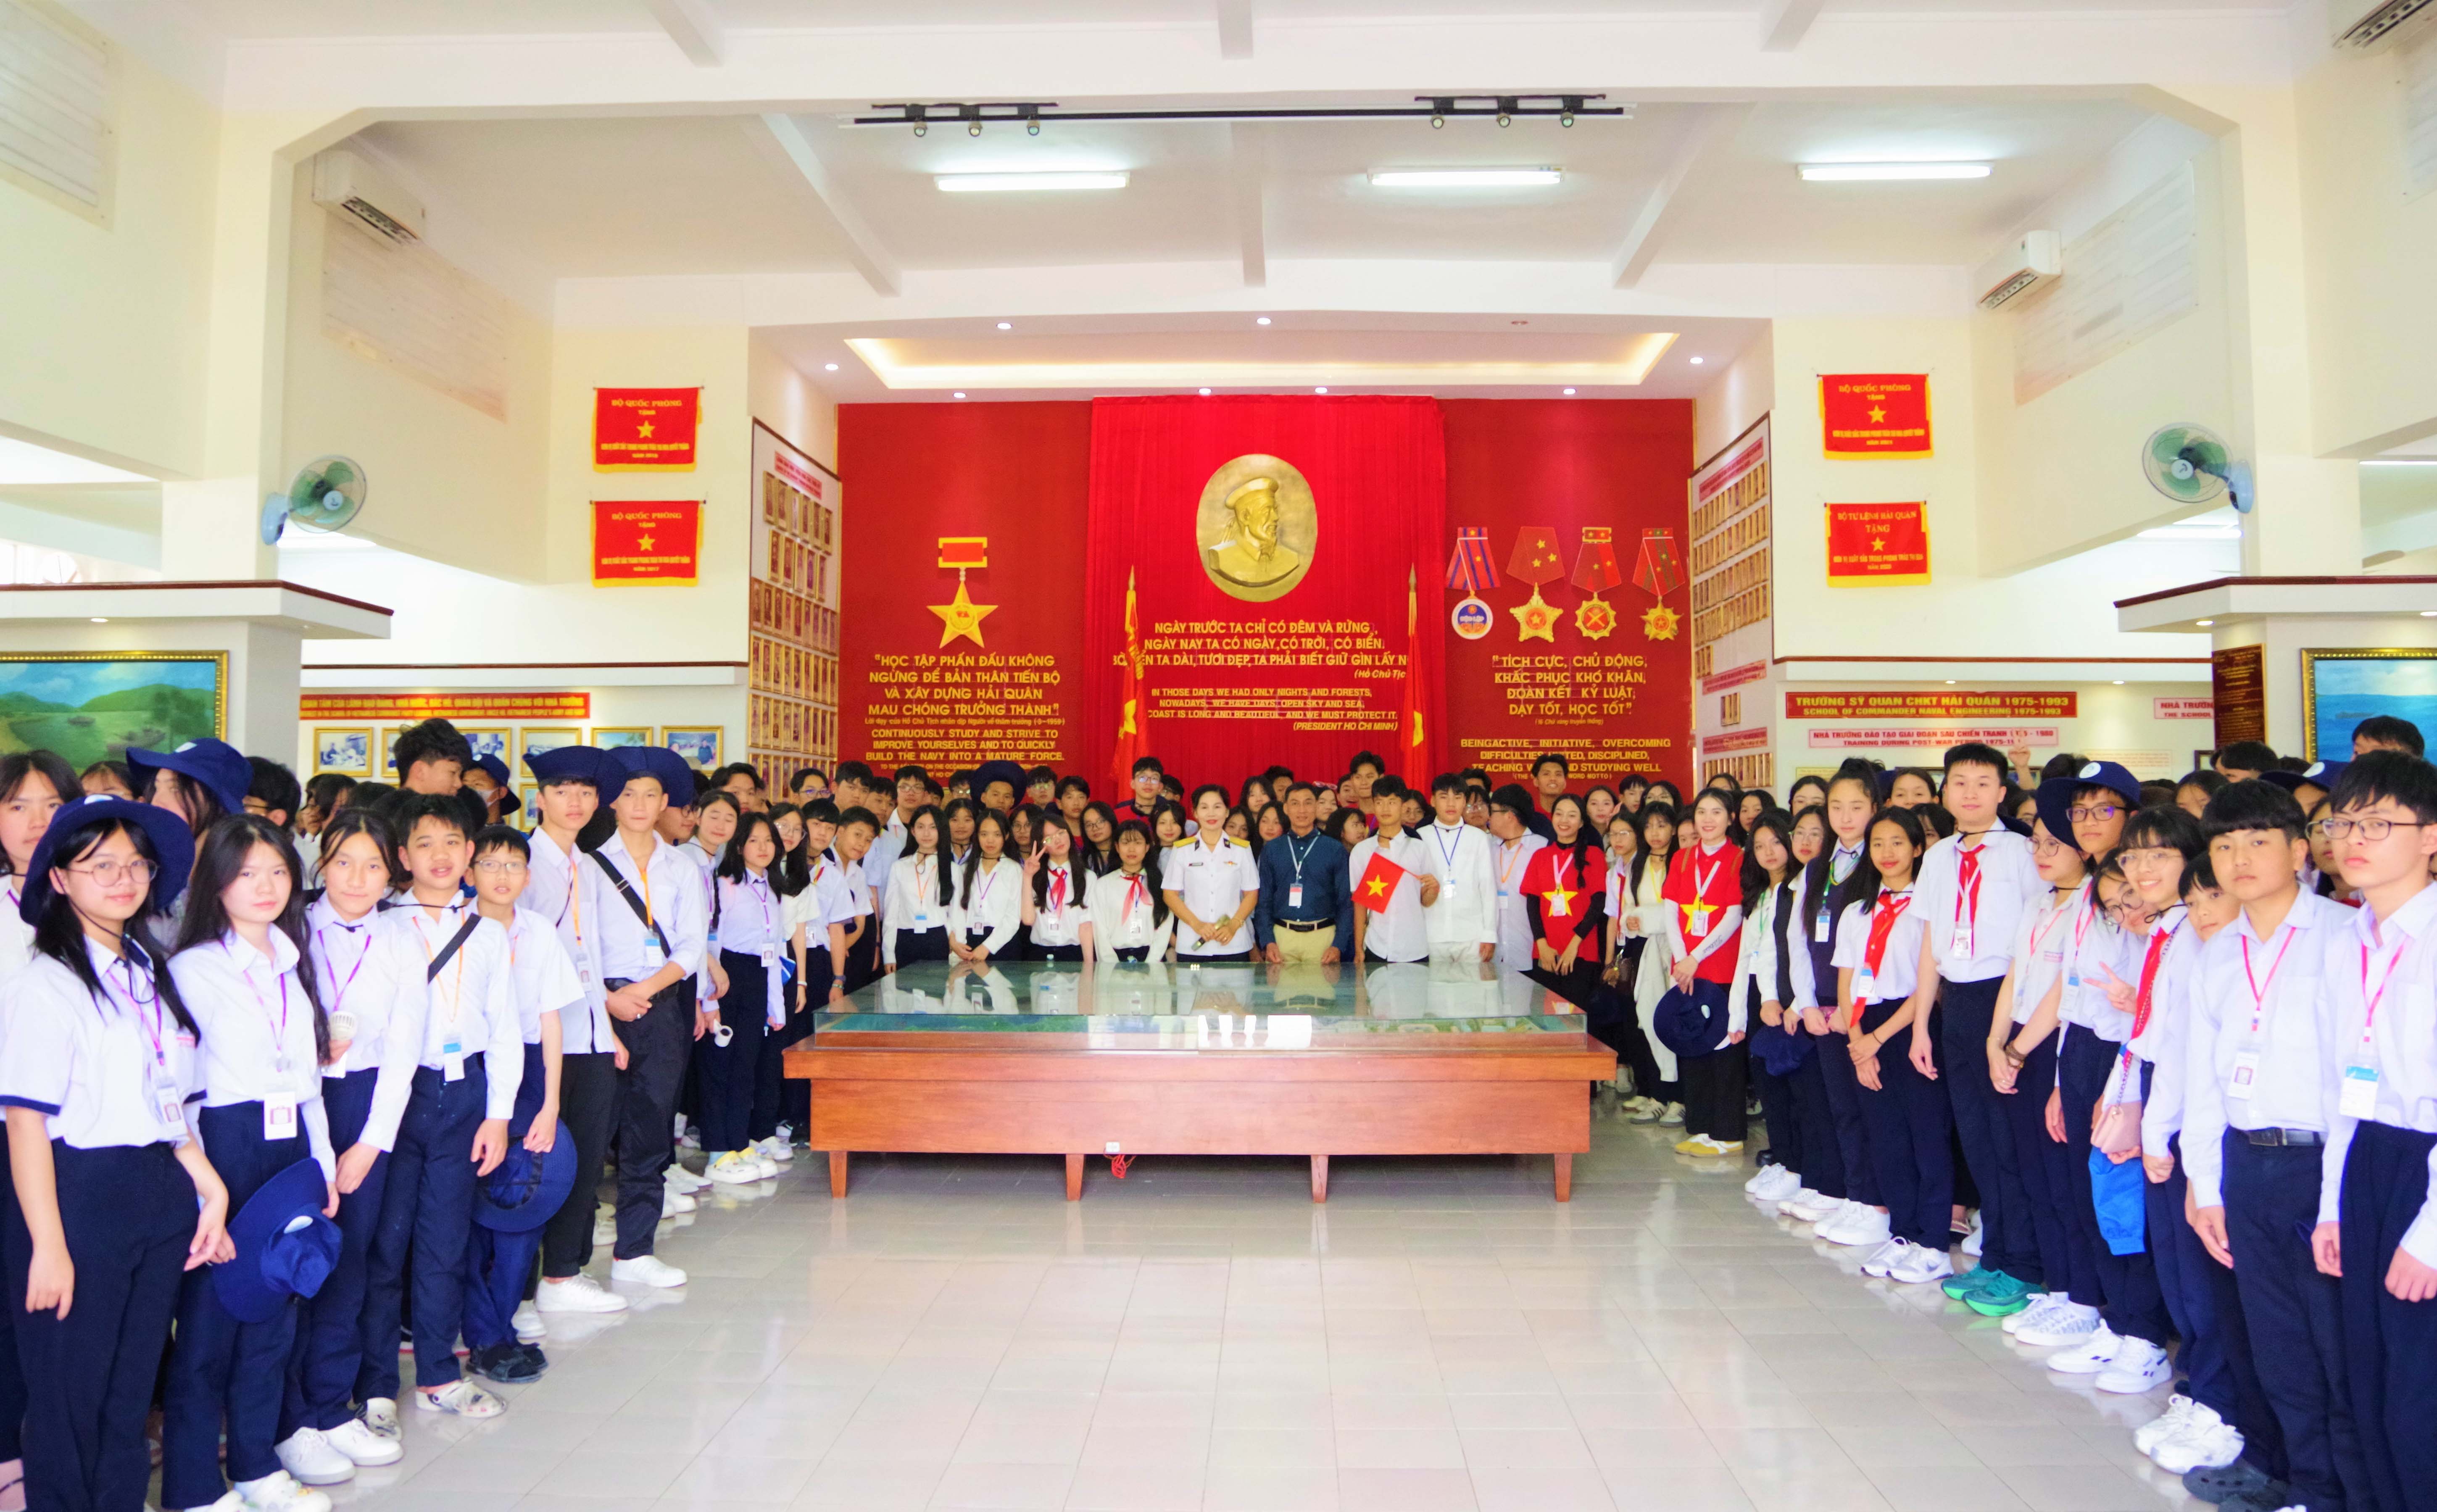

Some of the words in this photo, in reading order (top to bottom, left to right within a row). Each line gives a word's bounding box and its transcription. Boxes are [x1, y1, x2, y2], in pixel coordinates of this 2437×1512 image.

[1865, 524, 1890, 535] TẶNG
[1155, 620, 1187, 633] NGÀY
[1189, 619, 1226, 633] TRƯỚC
[1229, 622, 1243, 633] TA
[1245, 618, 1266, 633] CHỈ
[1268, 619, 1286, 633] CÓ
[1289, 619, 1315, 633] ĐÊM
[1318, 620, 1333, 633] VÀ
[1144, 636, 1177, 649] NGÀY
[1179, 638, 1203, 649] NAY
[1206, 638, 1220, 649] TA
[1222, 635, 1241, 649] CÓ
[1301, 635, 1329, 651] TRỜI,
[1333, 635, 1352, 649] CÓ
[914, 653, 936, 669] TẬP
[940, 651, 975, 666] PHẤN
[978, 652, 1005, 666] ĐẤU
[1009, 653, 1055, 667] KHÔNG
[1157, 654, 1170, 665] TA
[1173, 651, 1197, 667] DÀI,
[1199, 653, 1225, 665] TƯƠI
[1227, 654, 1251, 668] ĐẸP,
[1253, 654, 1267, 665] TA
[1270, 650, 1296, 665] PHẢI
[1300, 650, 1323, 665] BIẾT
[1325, 652, 1348, 665] GIỮ
[1351, 651, 1372, 665] GÌN
[1375, 651, 1395, 665] LẤY
[1535, 654, 1568, 669] CỰC,
[1573, 651, 1600, 667] CHỦ
[1604, 653, 1647, 669] ĐỘNG,
[869, 670, 918, 683] NGỪNG
[922, 667, 941, 683] ĐỂ
[944, 668, 971, 683] BẢN
[975, 669, 1009, 683] THÂN
[1013, 668, 1039, 683] TIẾN
[1043, 669, 1061, 686] BỘ
[1494, 667, 1530, 683] KHẮC
[1536, 672, 1570, 686] PHỤC
[1576, 669, 1602, 683] KHÓ
[1607, 669, 1647, 684] KHĂN,
[884, 685, 901, 699] VÀ
[905, 685, 930, 699] XÂY
[933, 686, 972, 702] DỰNG
[977, 684, 999, 700] HẢI
[1004, 686, 1043, 700] QUÂN
[1151, 688, 1160, 696] IN
[1162, 688, 1190, 696] THOSE
[1192, 688, 1214, 696] DAYS
[1216, 688, 1229, 696] WE
[1232, 688, 1250, 696] HAD
[1252, 688, 1274, 696] ONLY
[1277, 688, 1308, 696] NIGHTS
[1311, 688, 1329, 696] AND
[1331, 688, 1372, 697] FORESTS,
[1507, 685, 1545, 699] ĐOÀN
[1548, 684, 1571, 698] KẾT
[1581, 683, 1599, 698] KỶ
[1280, 699, 1303, 708] OPEN
[1306, 699, 1324, 708] SKY
[1324, 700, 1343, 708] AND
[1869, 697, 1902, 706] QUAN
[1906, 697, 1938, 706] CHKT
[1966, 696, 2000, 706] QUÂN
[2005, 697, 2069, 706] 1975-1993
[868, 704, 898, 715] MAU
[902, 701, 950, 715] CHÓNG
[954, 700, 1006, 715] TRƯỞNG
[1509, 703, 1534, 718] DẠY
[1539, 701, 1563, 716] TỐT,
[1569, 703, 1597, 719] HỌC
[1178, 710, 1186, 718] IS
[1286, 711, 1304, 719] AND
[1306, 711, 1319, 719] WE
[1321, 711, 1344, 719] MUST
[1346, 711, 1386, 719] PROTECT
[1388, 711, 1398, 719] IT.
[1293, 722, 1343, 731] (PRESIDENT
[1344, 722, 1357, 730] HO
[1358, 722, 1373, 730] CHI
[1373, 722, 1398, 731] MINH)
[871, 729, 945, 738] CONTINUOUSLY
[948, 729, 980, 738] STUDY
[983, 729, 1003, 738] AND
[1006, 729, 1041, 738] STRIVE
[1045, 729, 1059, 738] TO
[873, 740, 914, 749] IMPROVE
[917, 740, 977, 749] YOURSELVES
[979, 740, 999, 749] AND
[1001, 740, 1014, 749] TO
[1016, 740, 1056, 750] QUICKLY
[1539, 738, 1595, 748] INITIATIVE,
[1602, 738, 1671, 748] OVERCOMING
[866, 752, 893, 761] BUILD
[898, 752, 916, 761] THE
[920, 752, 945, 761] NAVY
[949, 752, 972, 761] INTO
[975, 752, 982, 761] A
[985, 752, 1025, 761] MATURE
[1030, 752, 1065, 761] FORCE.
[1588, 751, 1650, 761] DISCIPLINED,
[1581, 763, 1631, 772] STUDYING
[1633, 763, 1662, 772] WELL
